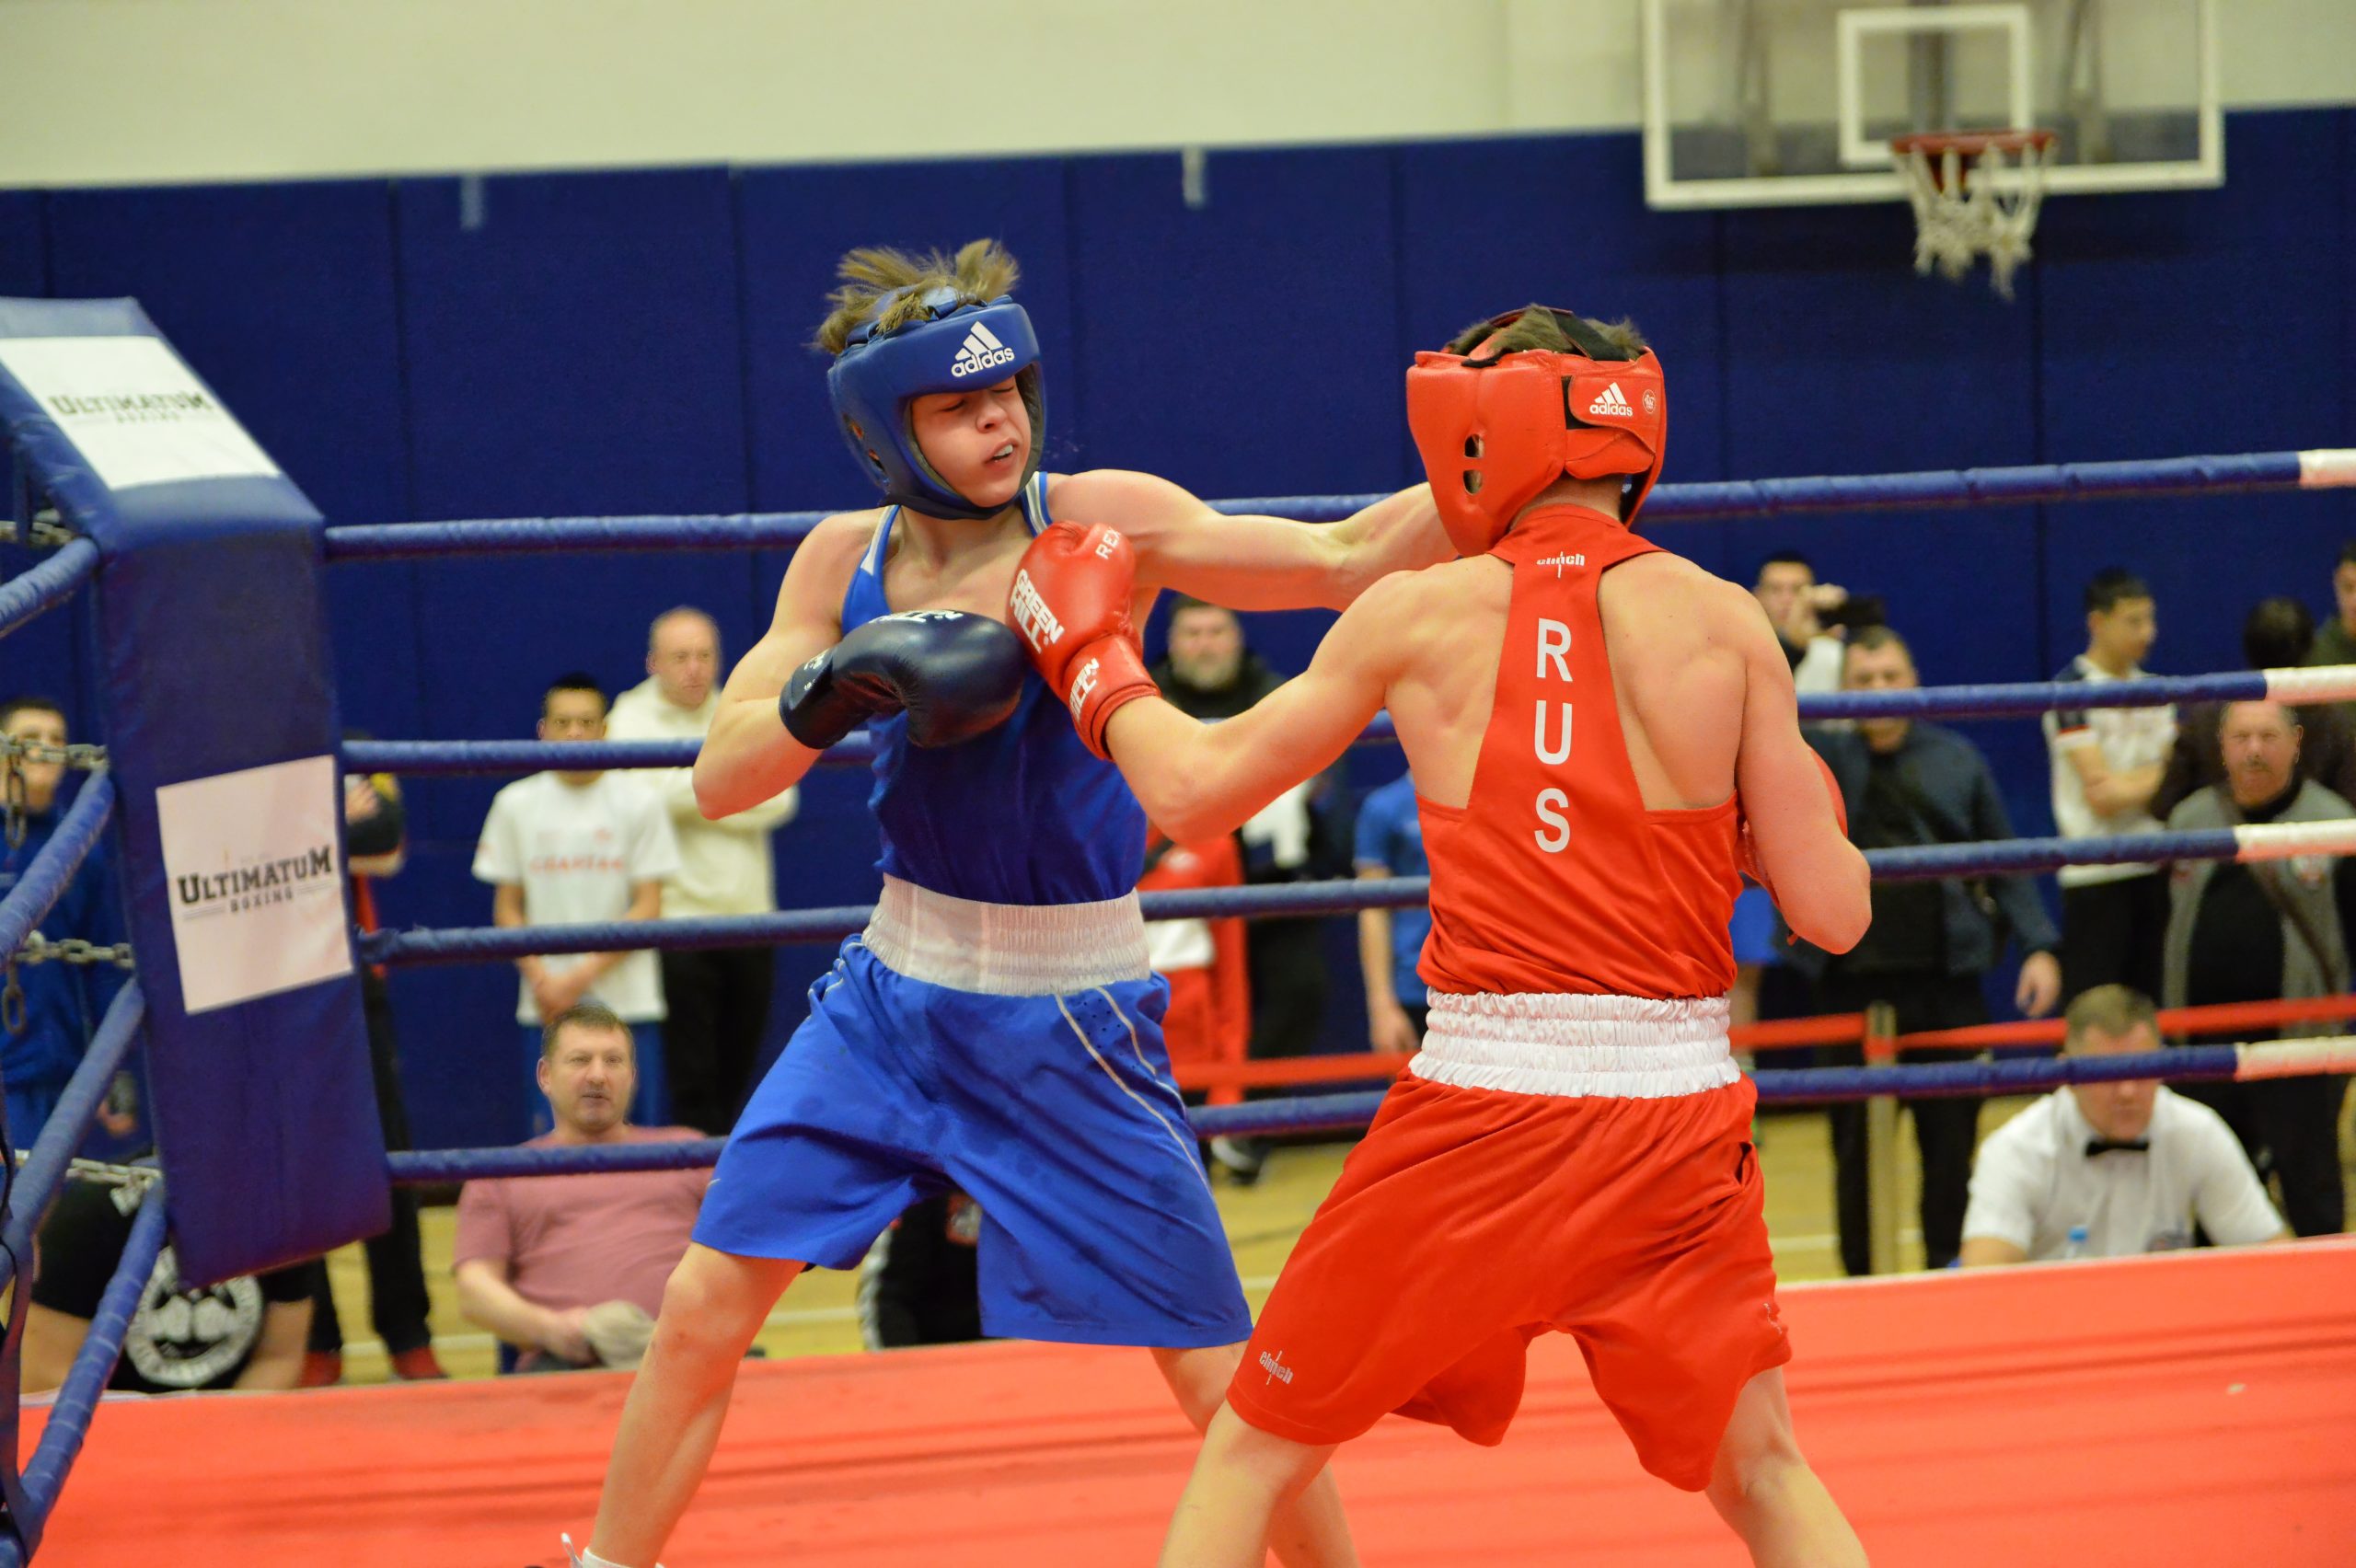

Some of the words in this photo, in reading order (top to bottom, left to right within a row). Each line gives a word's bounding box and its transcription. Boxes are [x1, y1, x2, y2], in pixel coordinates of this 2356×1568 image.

[951, 348, 1015, 377] adidas
[1589, 403, 1634, 417] adidas
[1016, 568, 1066, 644] GREEN
[177, 845, 332, 905] ULTIMATUM
[229, 886, 294, 913] BOXING
